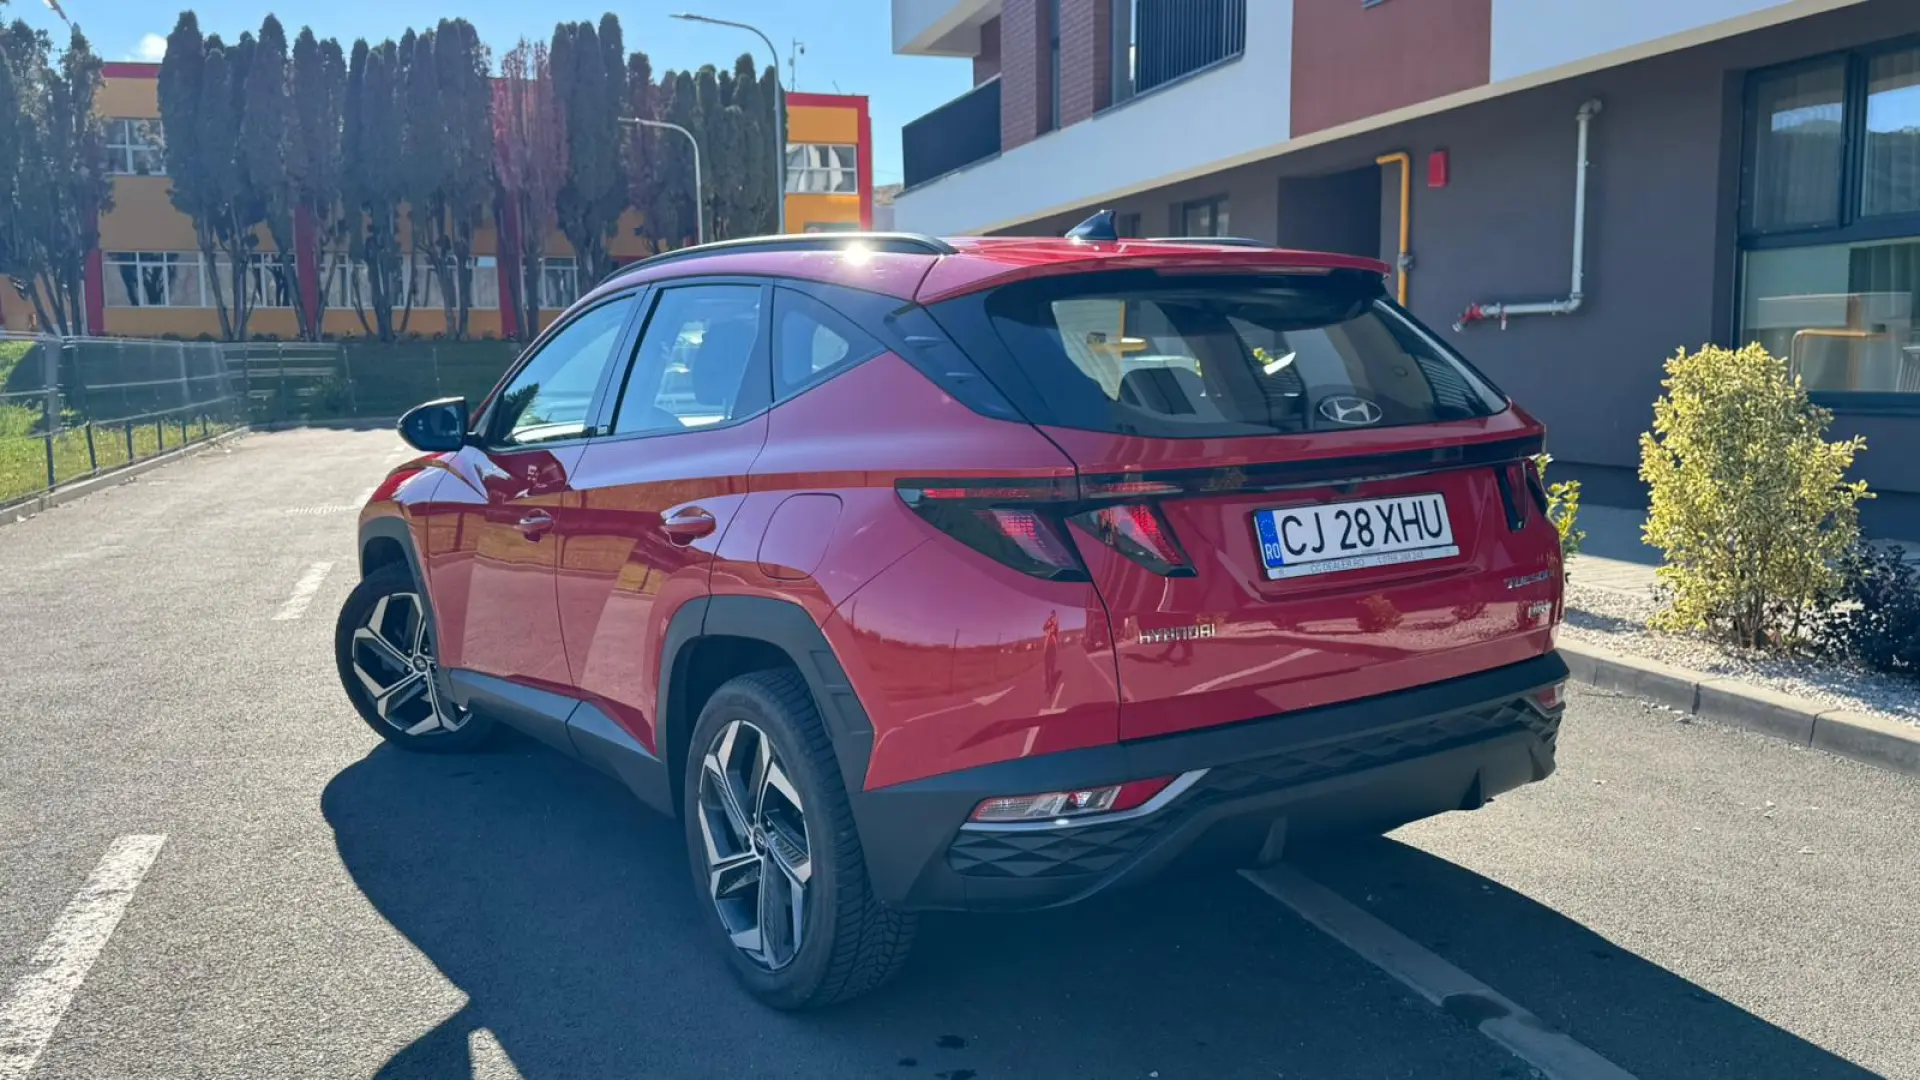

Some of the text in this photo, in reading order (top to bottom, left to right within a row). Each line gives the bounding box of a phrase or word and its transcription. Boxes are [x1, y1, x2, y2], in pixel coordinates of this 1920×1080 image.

[1281, 499, 1443, 556] CJ 28 XHU
[1264, 543, 1280, 560] RO
